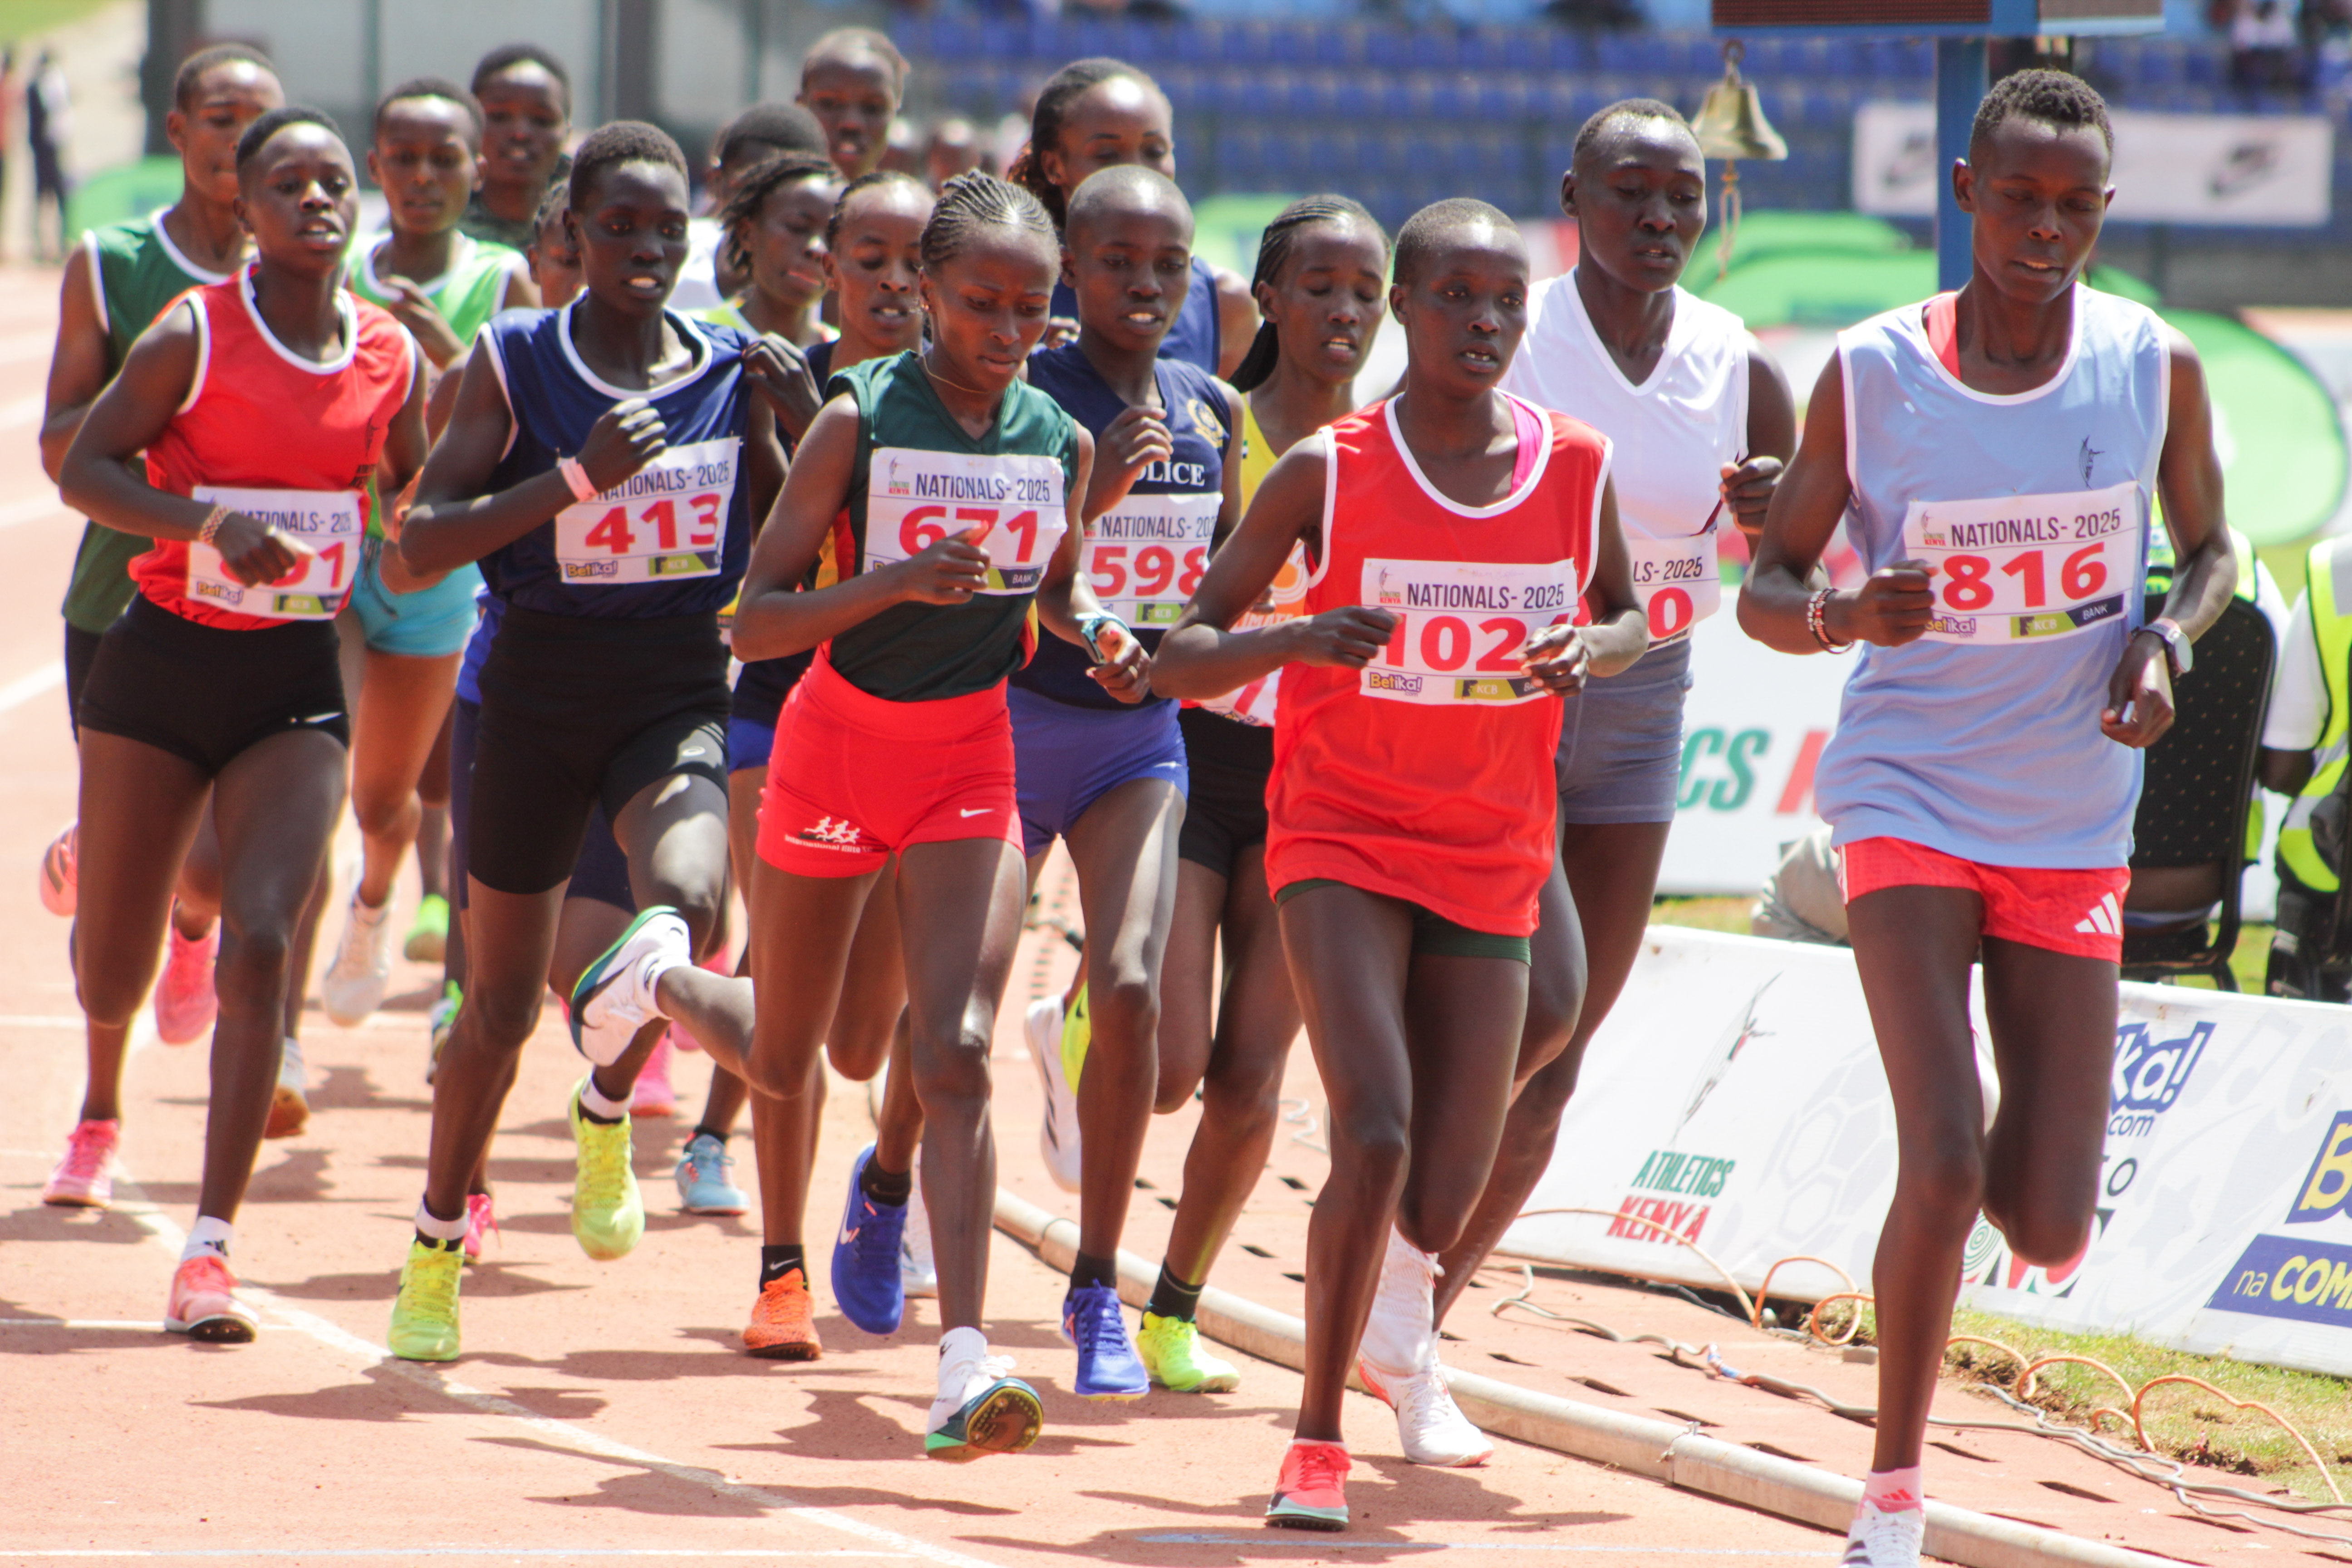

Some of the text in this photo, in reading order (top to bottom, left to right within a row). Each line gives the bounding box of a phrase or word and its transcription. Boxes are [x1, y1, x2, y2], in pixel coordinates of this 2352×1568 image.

[697, 461, 729, 487] 2025
[916, 473, 1051, 501] NATIONALS- 2025
[585, 493, 722, 555] 413
[899, 506, 1038, 563] 671
[1100, 516, 1192, 539] NATIONALS-
[1951, 508, 2121, 547] NATIONALS- 2025
[565, 560, 619, 579] Betika!
[1012, 574, 1033, 584] BANK
[1091, 545, 1208, 598] 598
[1663, 556, 1703, 580] 2025
[1943, 541, 2107, 611] 816
[1407, 583, 1564, 609] NATIONALS- 2025
[2033, 619, 2057, 631] KCB
[2082, 604, 2108, 621] BANK
[1370, 672, 1423, 693] Betika!
[1477, 685, 1498, 695] KCB
[1630, 1150, 1736, 1198] ATHLETICS
[1606, 1194, 1713, 1246] KENYA
[2233, 1254, 2352, 1310] na COM
